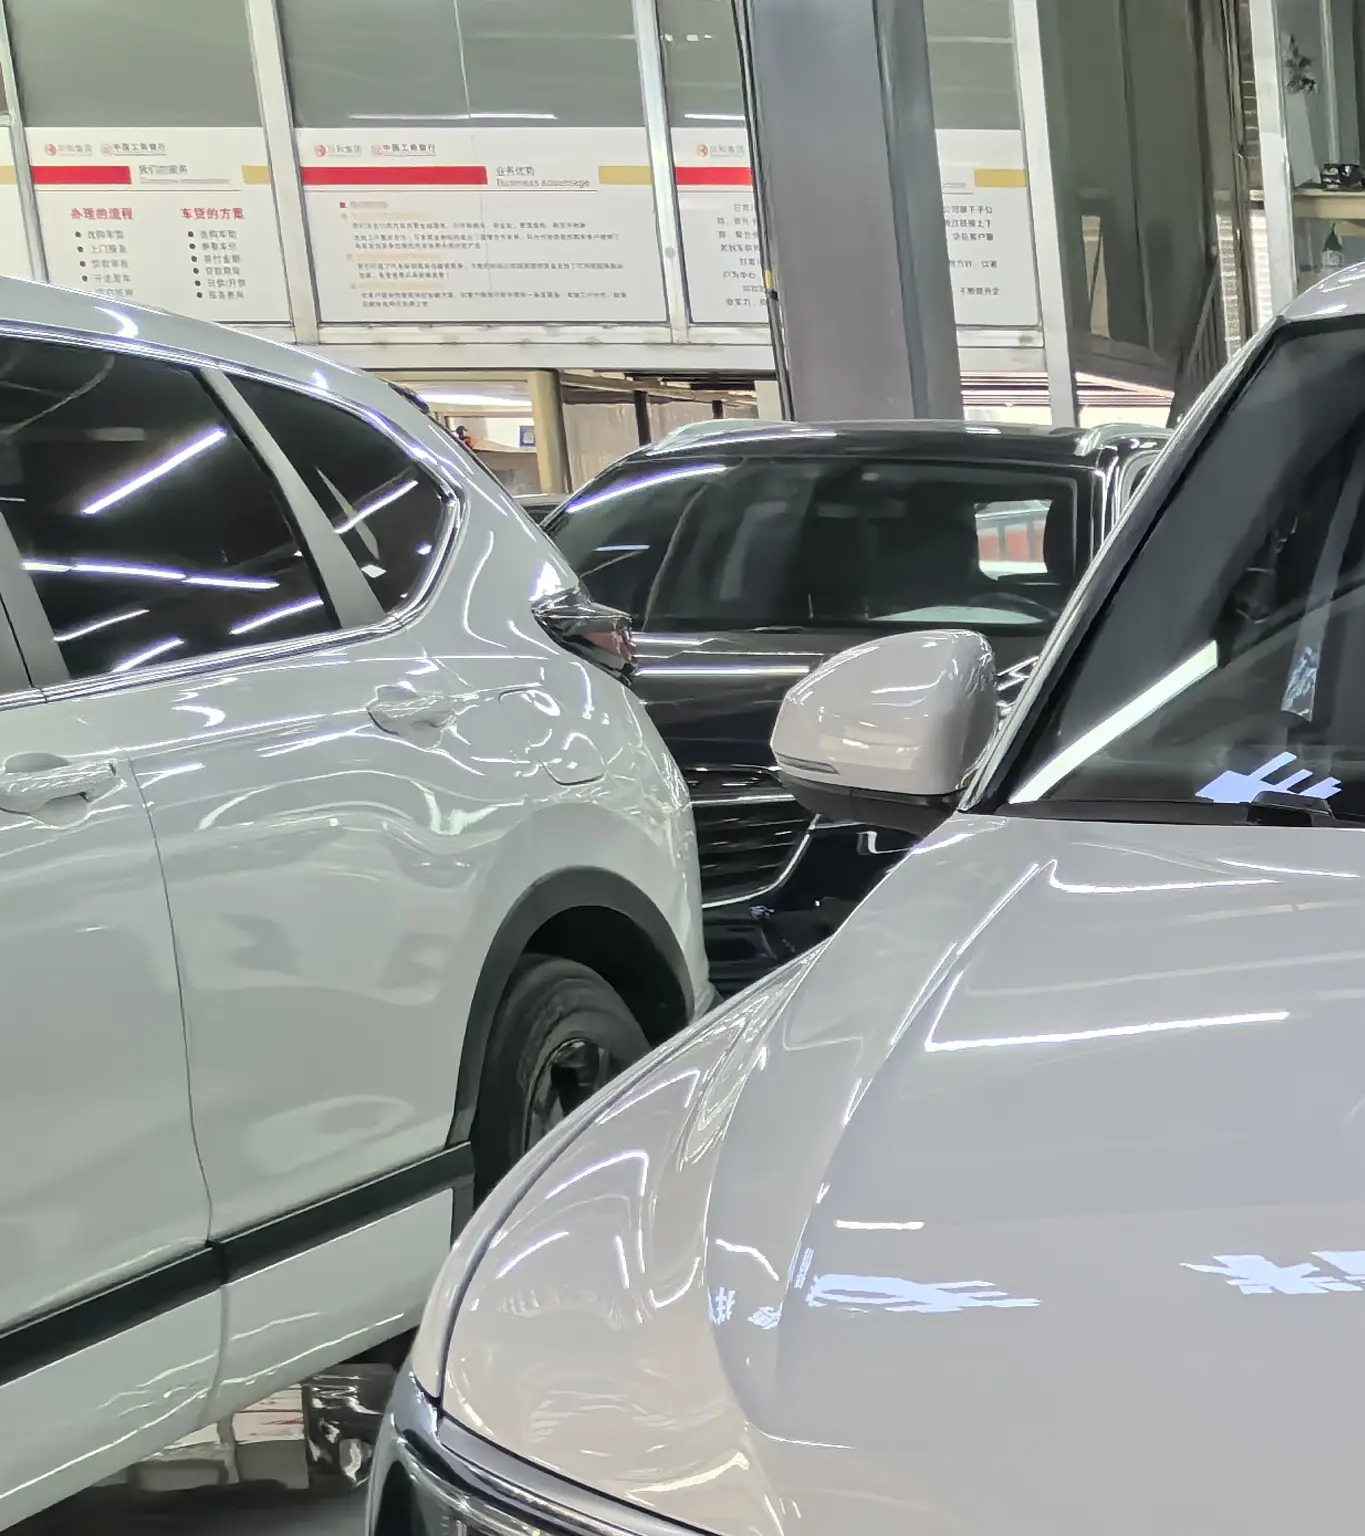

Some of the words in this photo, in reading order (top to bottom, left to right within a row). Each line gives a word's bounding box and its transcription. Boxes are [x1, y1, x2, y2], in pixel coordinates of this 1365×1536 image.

[382, 144, 435, 152] 中国工商银行
